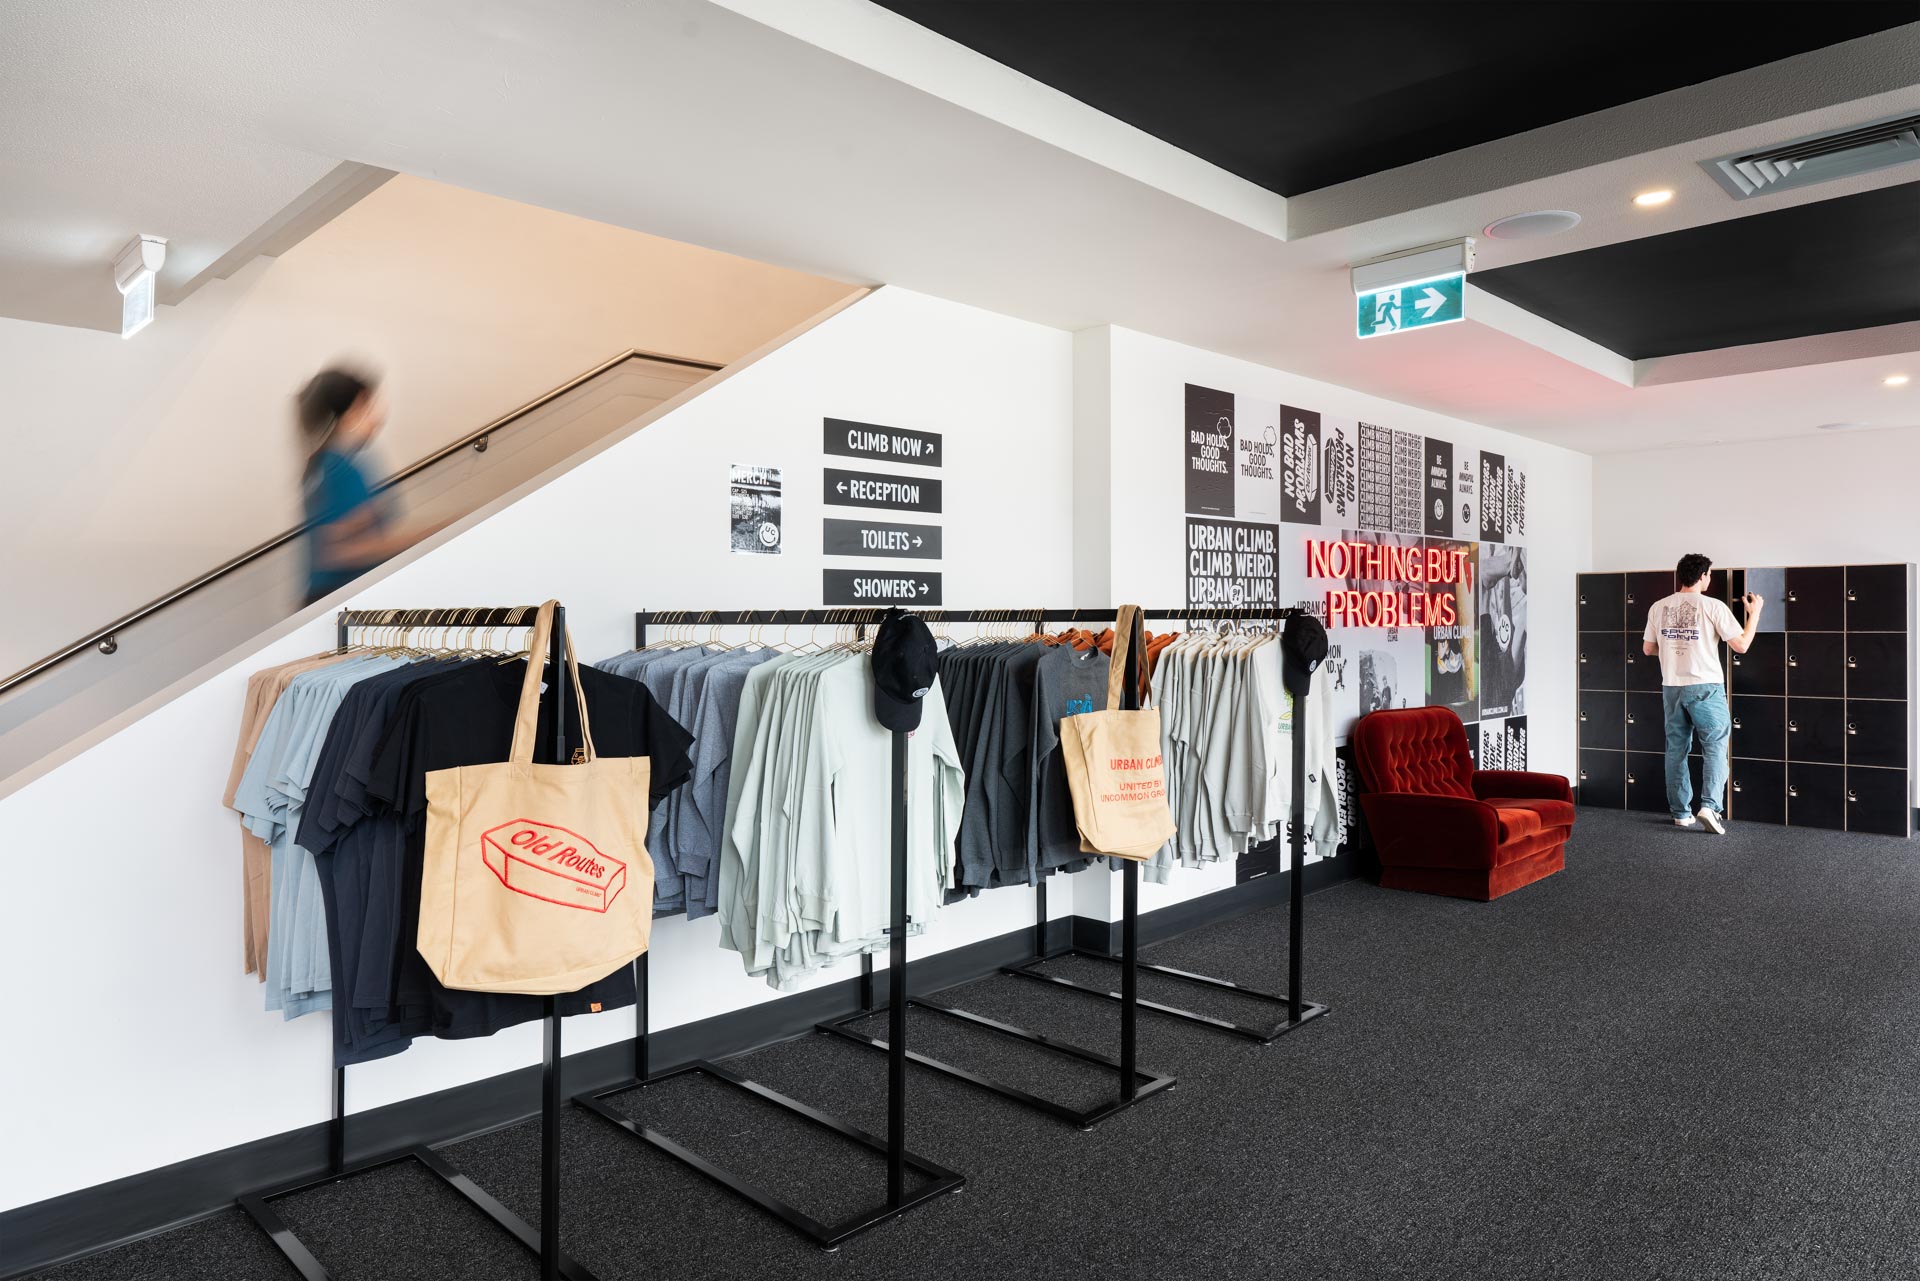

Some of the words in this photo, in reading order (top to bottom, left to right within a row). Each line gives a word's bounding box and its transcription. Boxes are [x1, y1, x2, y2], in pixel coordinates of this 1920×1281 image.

[848, 430, 889, 452] CLIMB
[892, 436, 922, 456] NOW
[1190, 430, 1204, 444] BAD
[1206, 433, 1230, 451] HOLDS,
[1200, 446, 1220, 459] GOOD
[1240, 439, 1252, 452] BAD
[1254, 442, 1274, 458] HOLDS,
[1284, 433, 1294, 469] BAD
[1192, 457, 1228, 474] THOUGHTS.
[1249, 453, 1266, 466] GOOD
[1346, 443, 1354, 468] NO
[1436, 454, 1442, 465] BE
[1464, 461, 1469, 470] BE
[731, 470, 770, 486] MERCH.
[1240, 464, 1274, 480] THOUGHTS.
[1284, 470, 1295, 498] NO
[850, 480, 920, 504] RECEPTION
[1346, 470, 1355, 502] BAD
[1482, 459, 1490, 532] OUTSIDERS
[1488, 474, 1496, 521] INSIDE
[1495, 466, 1504, 534] TOGETHER
[1506, 465, 1514, 534] OUTSIDERS
[1512, 480, 1520, 524] INSIDE
[1518, 472, 1526, 536] TOGETHER
[861, 530, 910, 550] TOILETS
[1189, 524, 1232, 552] URBAN
[1234, 527, 1277, 554] CLIMB.
[1189, 550, 1232, 576] CLIMB
[1234, 553, 1277, 578] WEIRD.
[1306, 538, 1424, 583] NOTHING
[1424, 548, 1469, 584] BUT
[853, 578, 916, 598] SHOWERS
[1189, 577, 1232, 602] URBAN
[1326, 590, 1456, 628] PROBLEMS
[1434, 626, 1452, 640] URBAN
[1110, 758, 1144, 770] URBAN
[1120, 782, 1152, 790] UNITED
[1346, 768, 1356, 793] NO
[1100, 792, 1150, 802] UNCOMMON
[1150, 790, 1166, 798] GRO
[511, 830, 564, 856] Old
[548, 846, 605, 878] Routes
